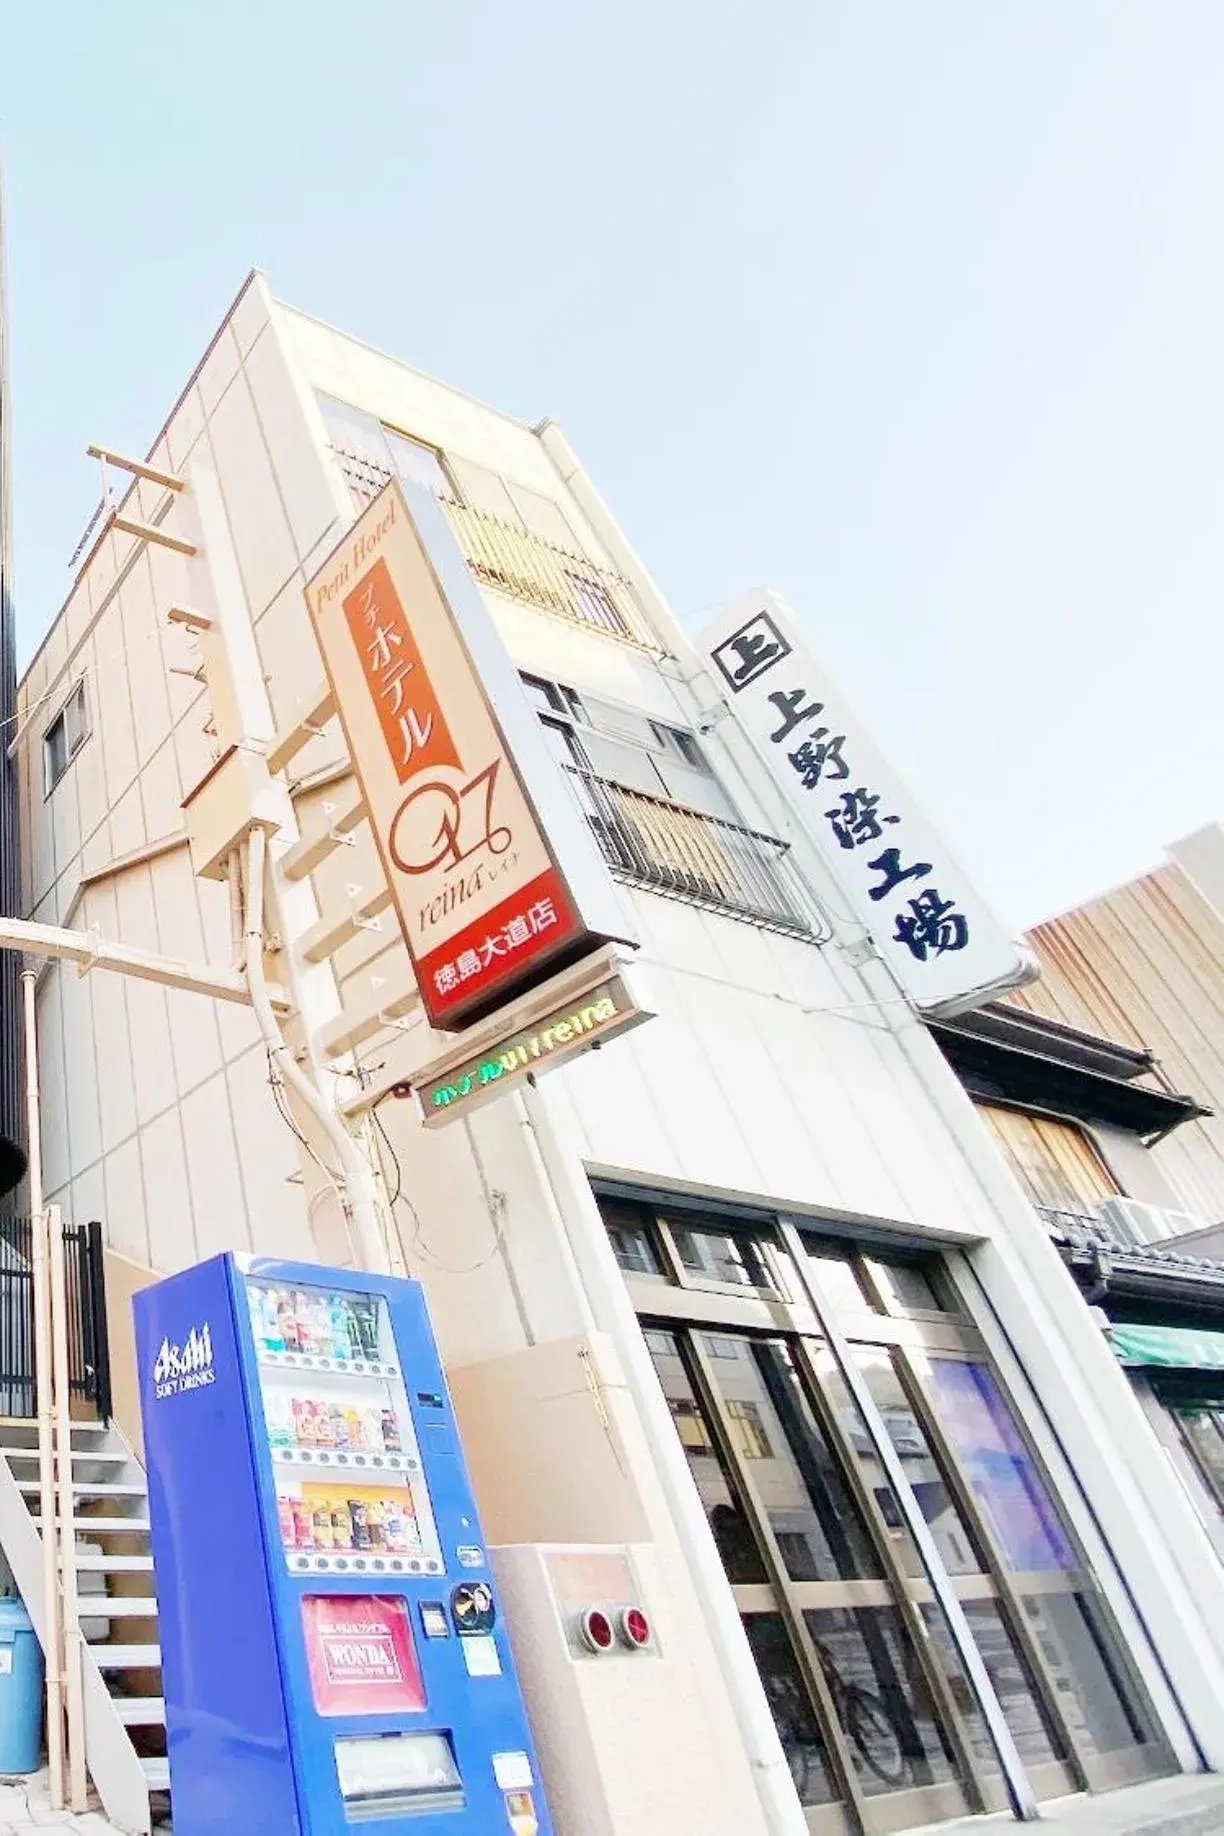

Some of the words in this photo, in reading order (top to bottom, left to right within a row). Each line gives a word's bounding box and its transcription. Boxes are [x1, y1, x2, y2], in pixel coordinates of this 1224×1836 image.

[316, 562, 351, 613] Petit
[353, 499, 397, 571] Hotel
[359, 582, 432, 764] プチホテル
[767, 688, 969, 962] 上野染工場
[418, 862, 484, 932] reina
[433, 897, 558, 996] 徳島大道店
[154, 1321, 213, 1383] Asahi
[156, 1380, 178, 1399] SOFT
[179, 1369, 216, 1393] DRINKS
[328, 1643, 392, 1666] WONDA
